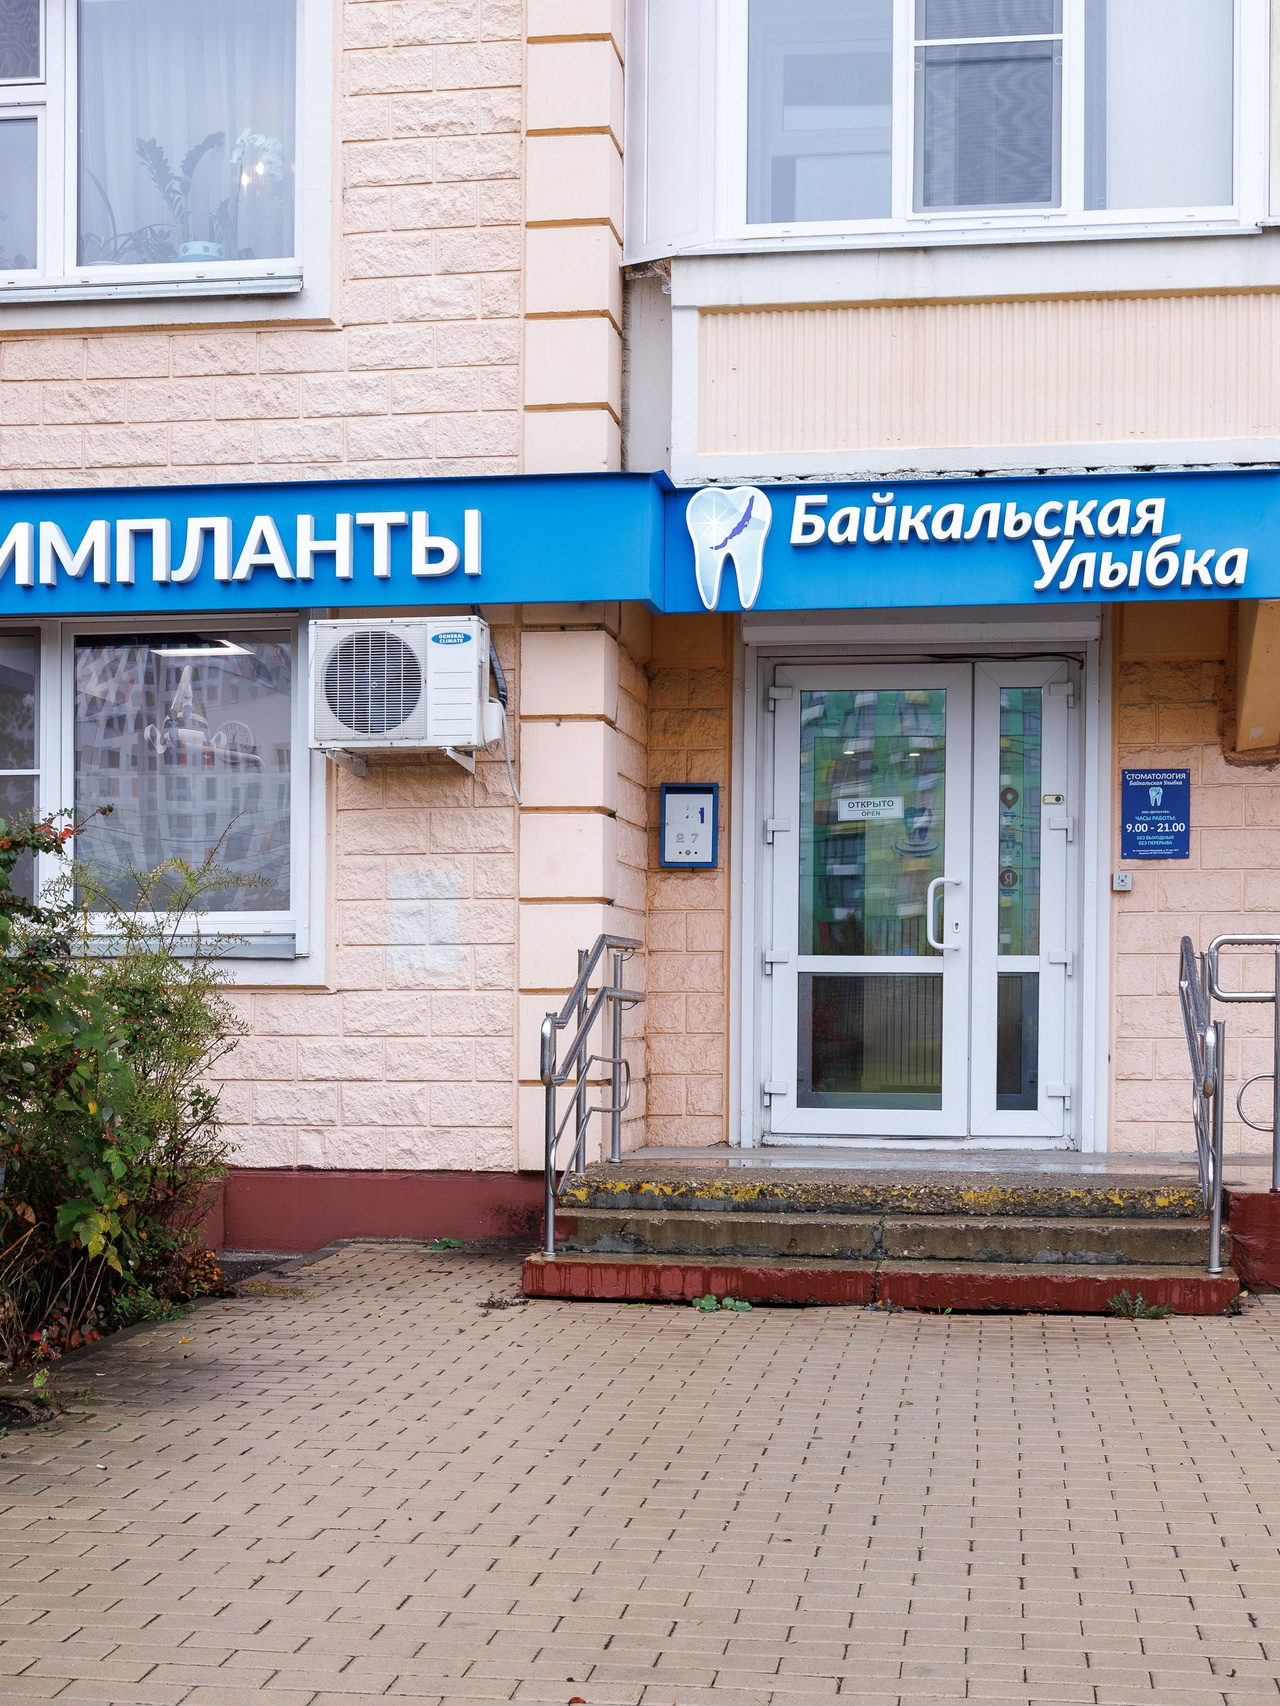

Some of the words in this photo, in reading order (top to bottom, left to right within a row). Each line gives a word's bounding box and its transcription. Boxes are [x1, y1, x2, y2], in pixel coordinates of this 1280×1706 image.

[790, 492, 1166, 546] Байкальская
[1031, 533, 1249, 592] Улыбка
[847, 800, 894, 809] ОТКРЫТО
[1126, 823, 1148, 833] 9.00
[1157, 822, 1186, 832] 21.00
